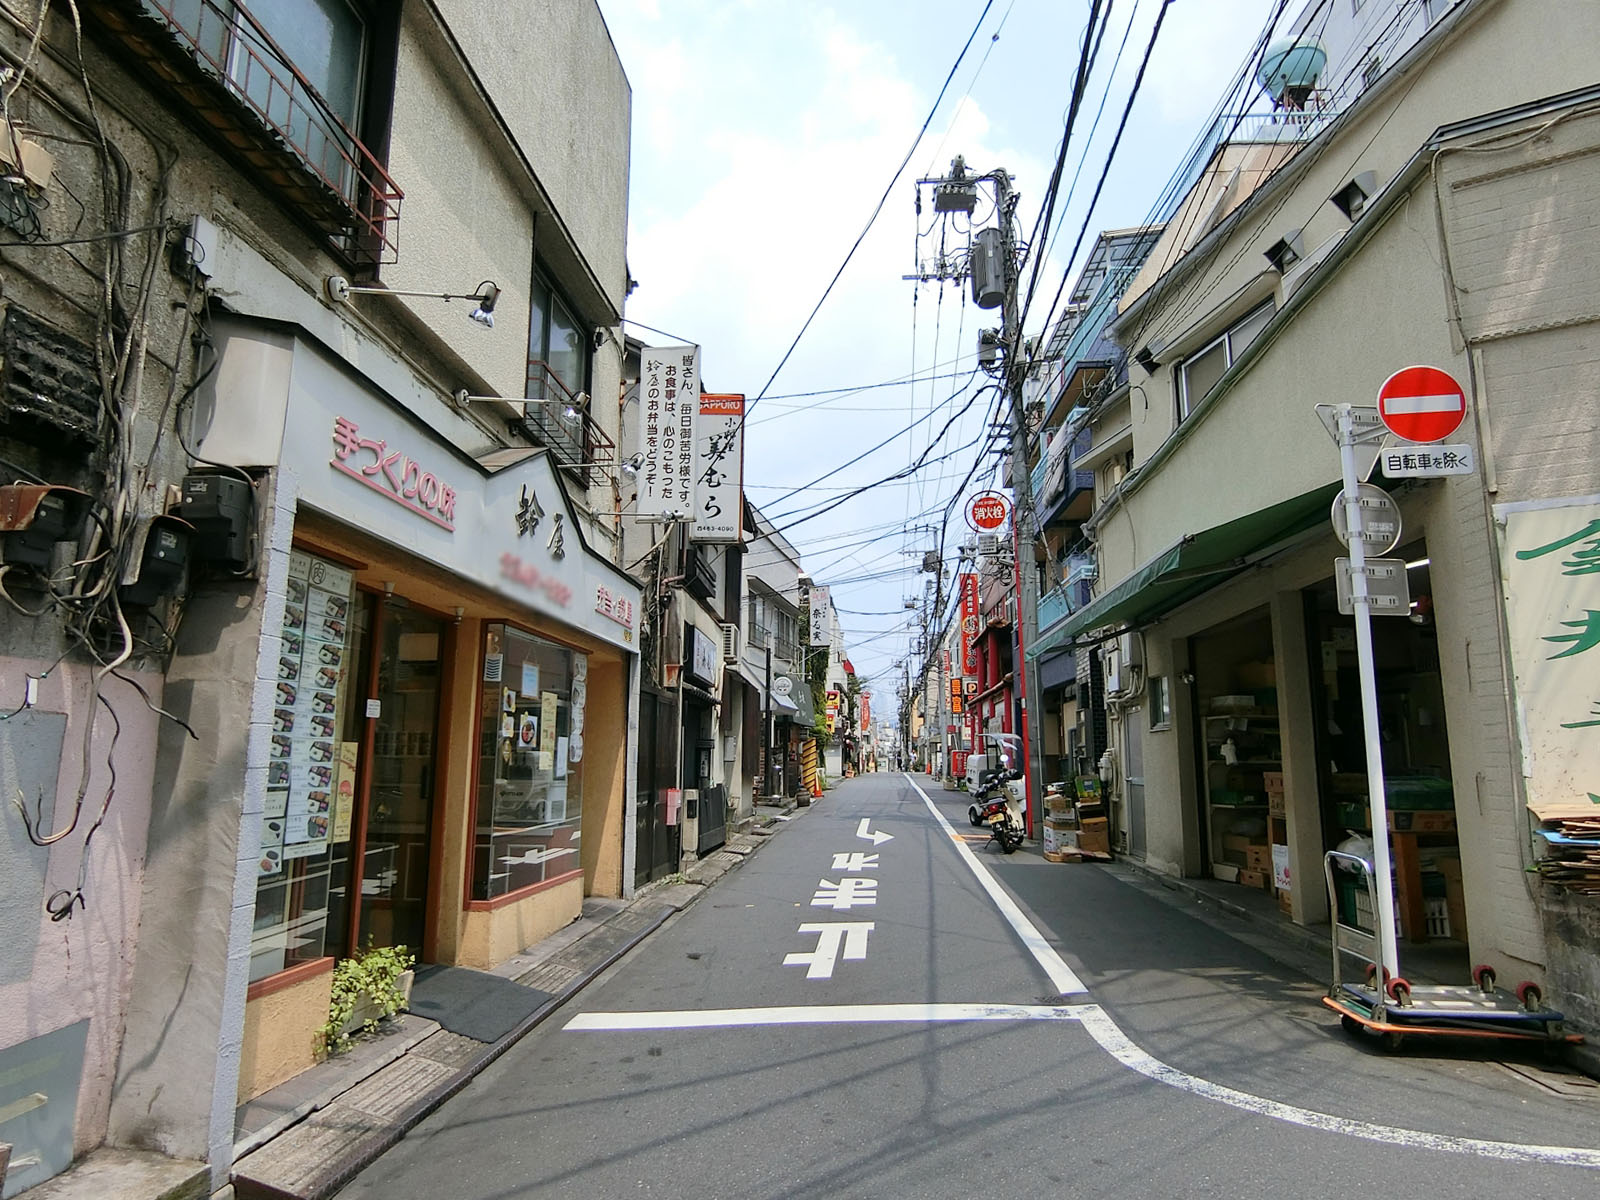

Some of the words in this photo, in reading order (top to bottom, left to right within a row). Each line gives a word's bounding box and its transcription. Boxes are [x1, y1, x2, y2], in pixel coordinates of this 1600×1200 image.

[661, 365, 677, 499] お食事は、心のこもった
[1388, 452, 1468, 472] 自転車を除く
[332, 415, 457, 521] 手づくりの味
[974, 505, 1004, 521] 消火栓
